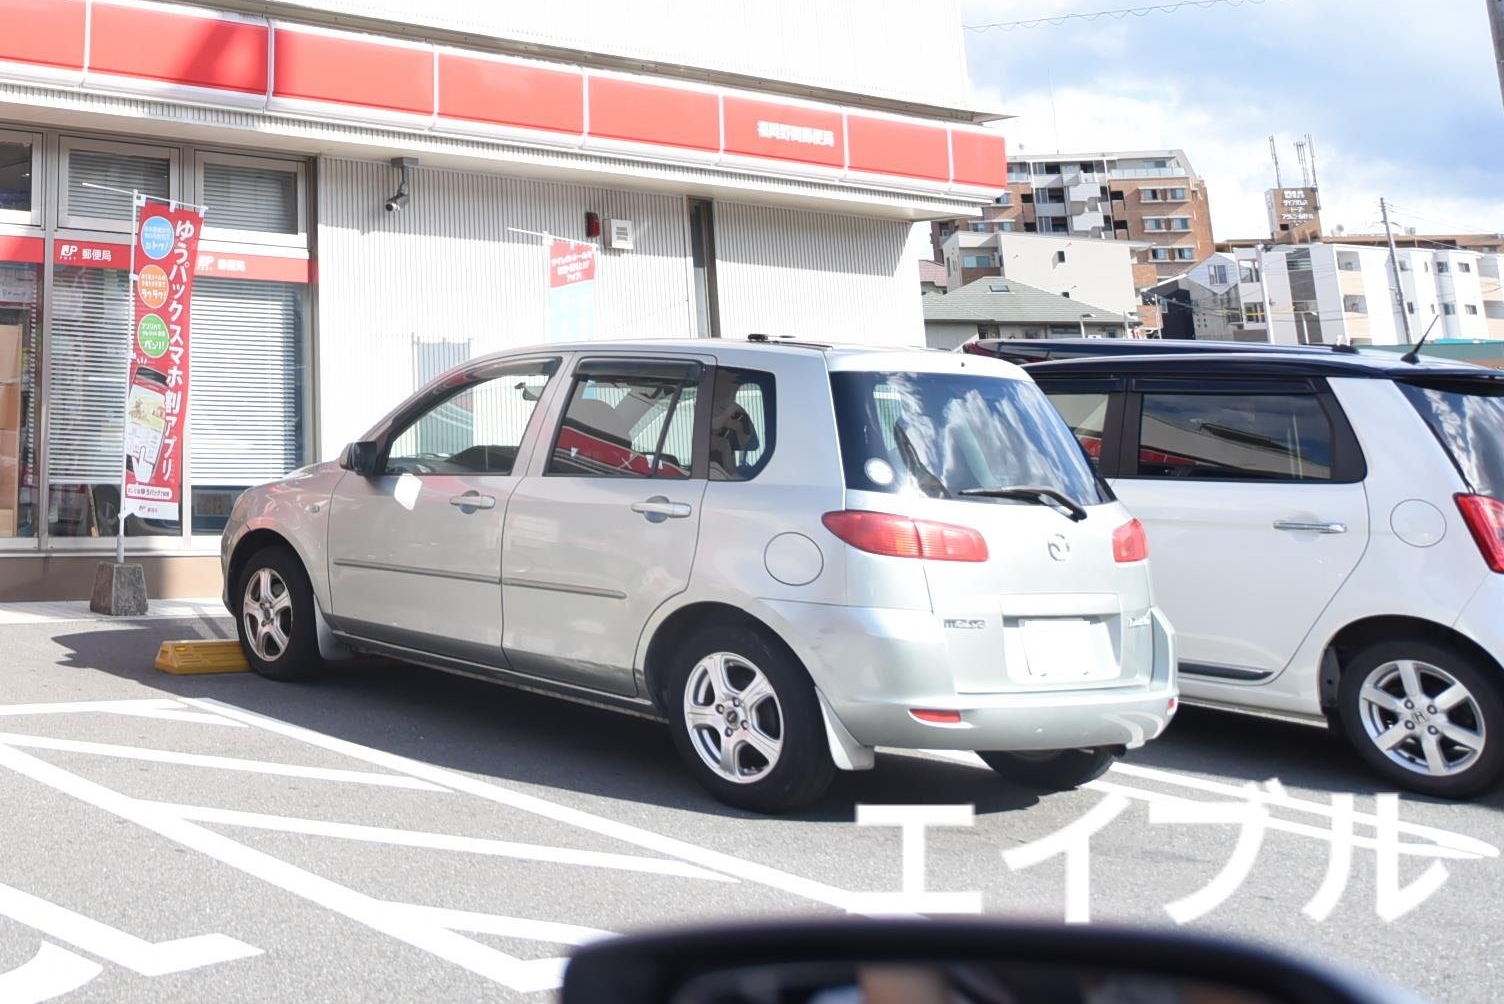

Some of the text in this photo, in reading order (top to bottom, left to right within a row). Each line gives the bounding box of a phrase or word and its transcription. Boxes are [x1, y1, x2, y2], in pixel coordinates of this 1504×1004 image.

[82, 248, 112, 262] 郵便局
[162, 219, 195, 482] ゆうパックスマホ割アプリ
